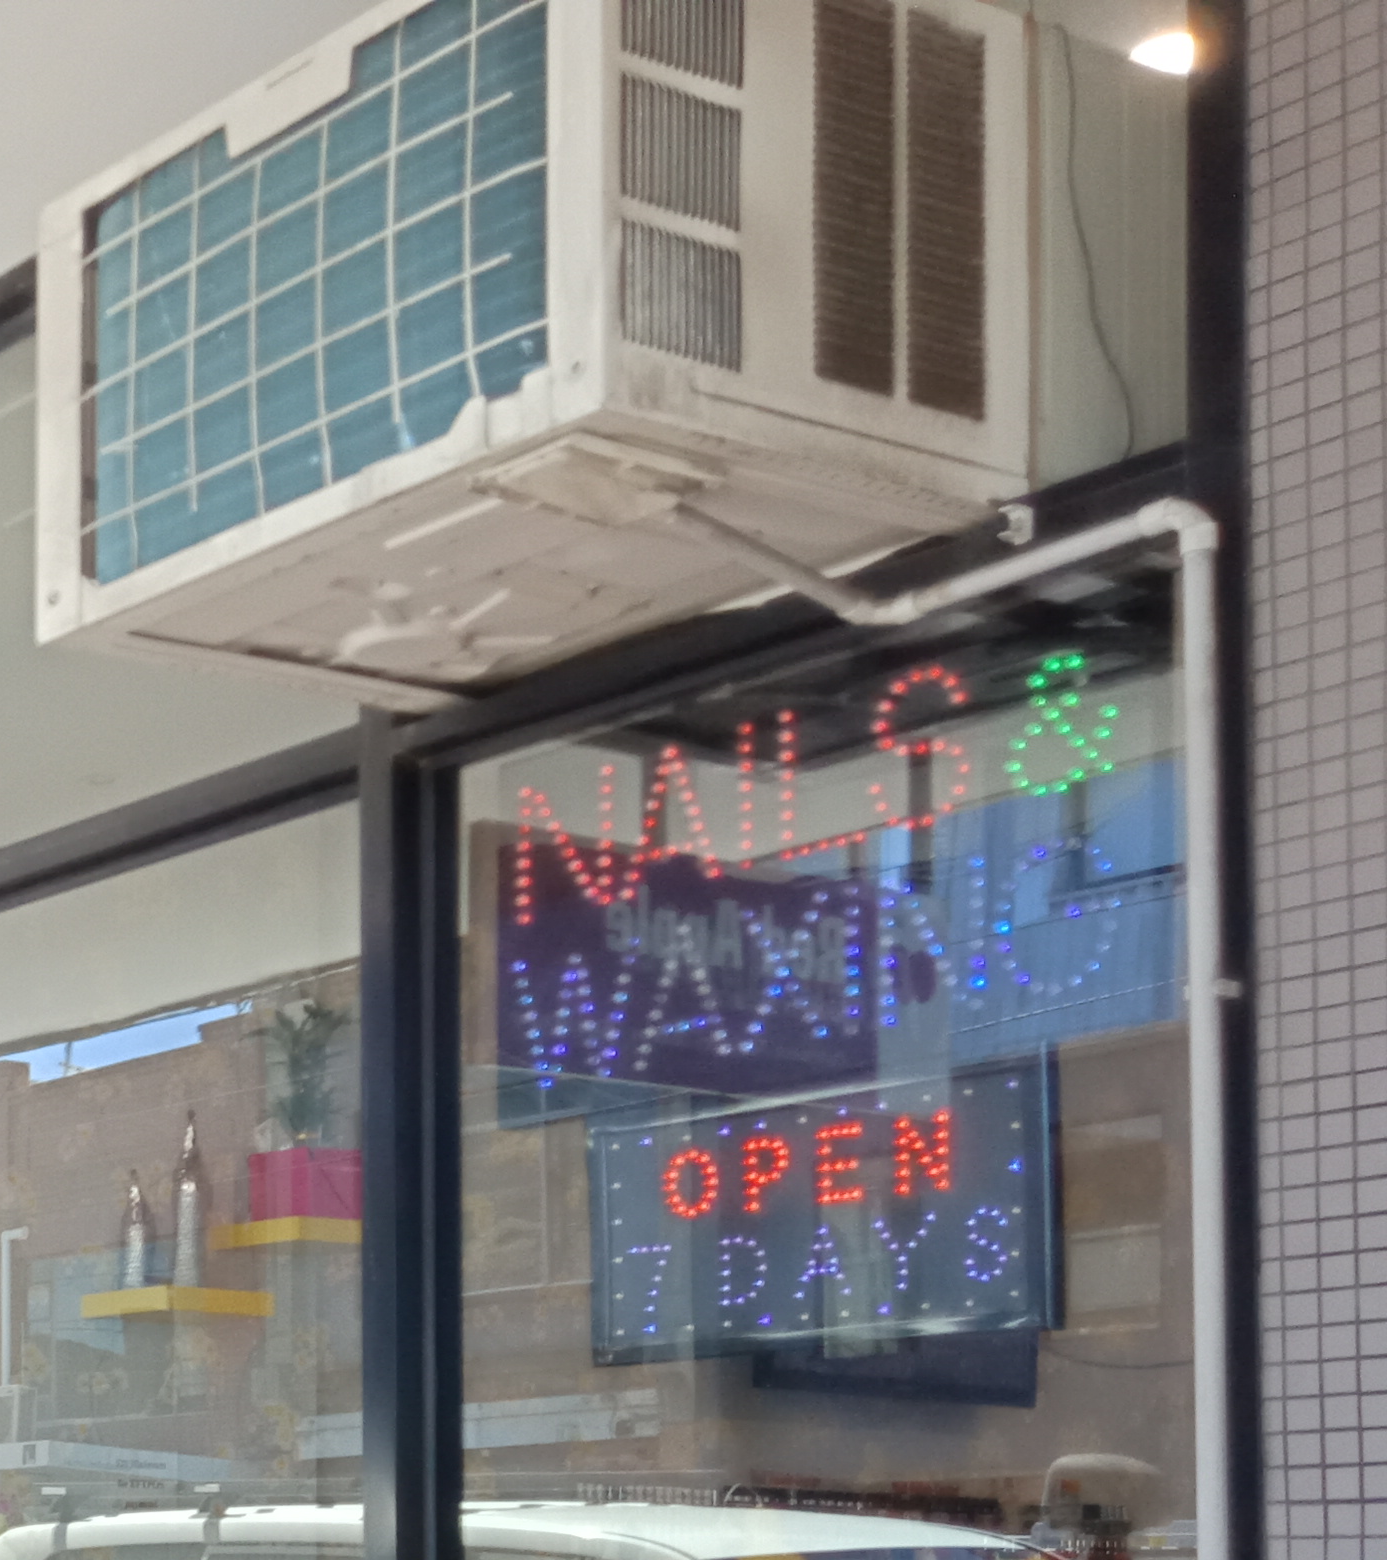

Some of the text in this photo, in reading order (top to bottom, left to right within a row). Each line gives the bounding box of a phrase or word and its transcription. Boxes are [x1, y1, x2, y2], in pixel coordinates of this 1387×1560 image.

[512, 651, 1121, 926] NAILS &
[509, 837, 1124, 1090] WAXING
[660, 1106, 952, 1219] OPEN
[627, 1204, 1010, 1315] 7 DAYS
